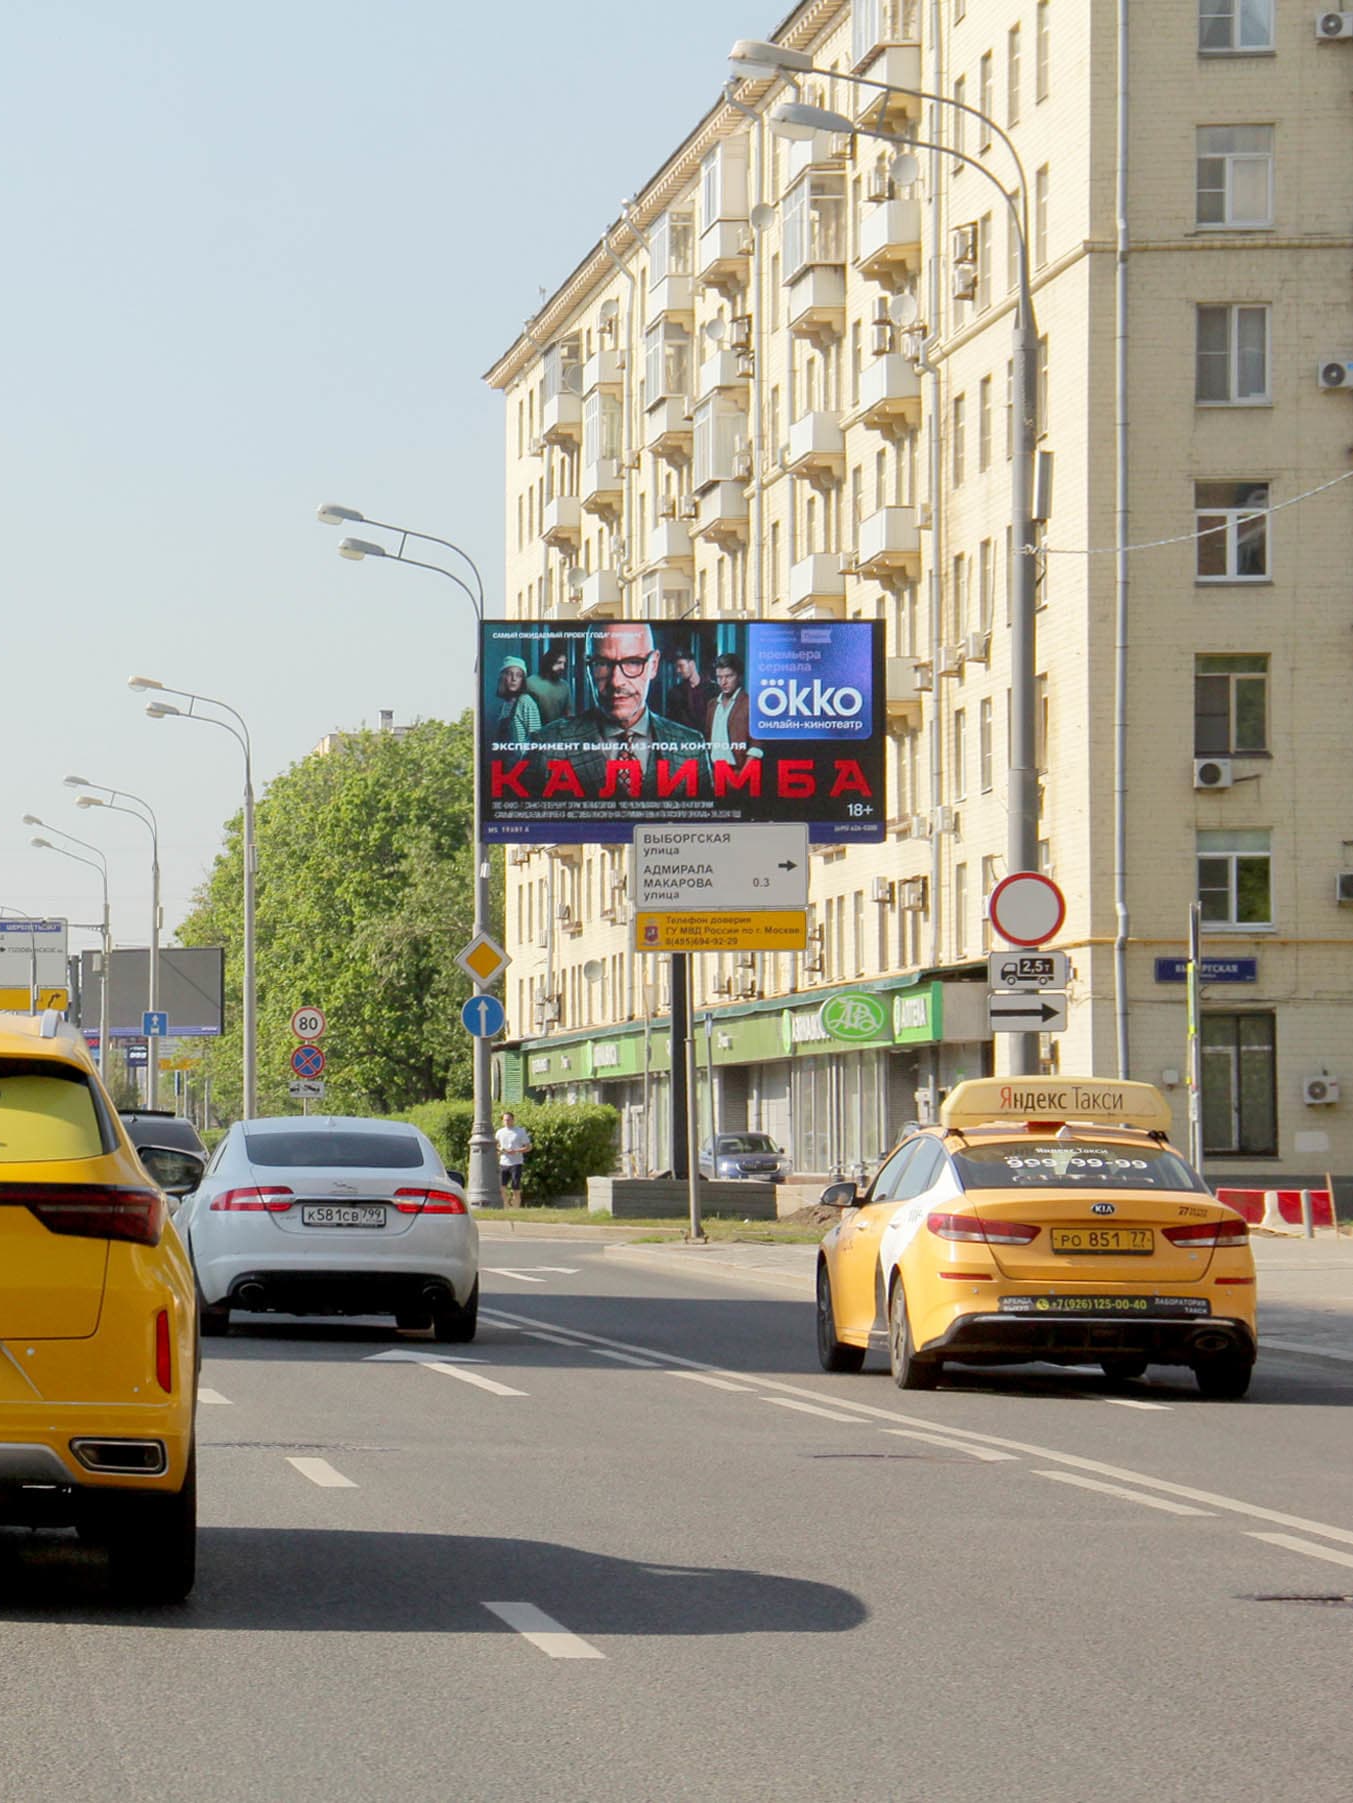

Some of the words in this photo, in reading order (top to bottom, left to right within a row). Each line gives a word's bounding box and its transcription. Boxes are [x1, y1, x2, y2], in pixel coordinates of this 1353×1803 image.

[759, 650, 821, 661] премьера
[759, 662, 812, 673] сериала
[758, 719, 863, 731] онлайн-кинотеатр
[491, 741, 580, 752] ЭКСПЕРИМЕНТ
[583, 741, 629, 751] ВЫШЕЛ
[630, 742, 678, 752] ИЗ-ПОД
[681, 741, 747, 751] КОНТРОЛЯ
[490, 759, 873, 798] КАЛИМБА
[847, 803, 874, 817] 18+
[643, 833, 731, 844] ВЫБОРГСКАЯ
[643, 846, 680, 857] улица
[643, 864, 714, 876] АДМИРАЛА
[643, 877, 713, 888] МАКАРОВА
[752, 877, 770, 888] 0.3
[643, 891, 680, 902] улица
[665, 916, 708, 926] Телефон
[710, 917, 751, 926] доверия
[665, 927, 678, 936] ГУ
[680, 927, 703, 936] МВД
[704, 926, 739, 936] России
[742, 928, 754, 936] по
[764, 926, 800, 935] Москве
[299, 1016, 318, 1030] 80
[1000, 1086, 1068, 1112] Яндекс
[1072, 1086, 1124, 1110] Такси
[1094, 1205, 1113, 1214] KIA
